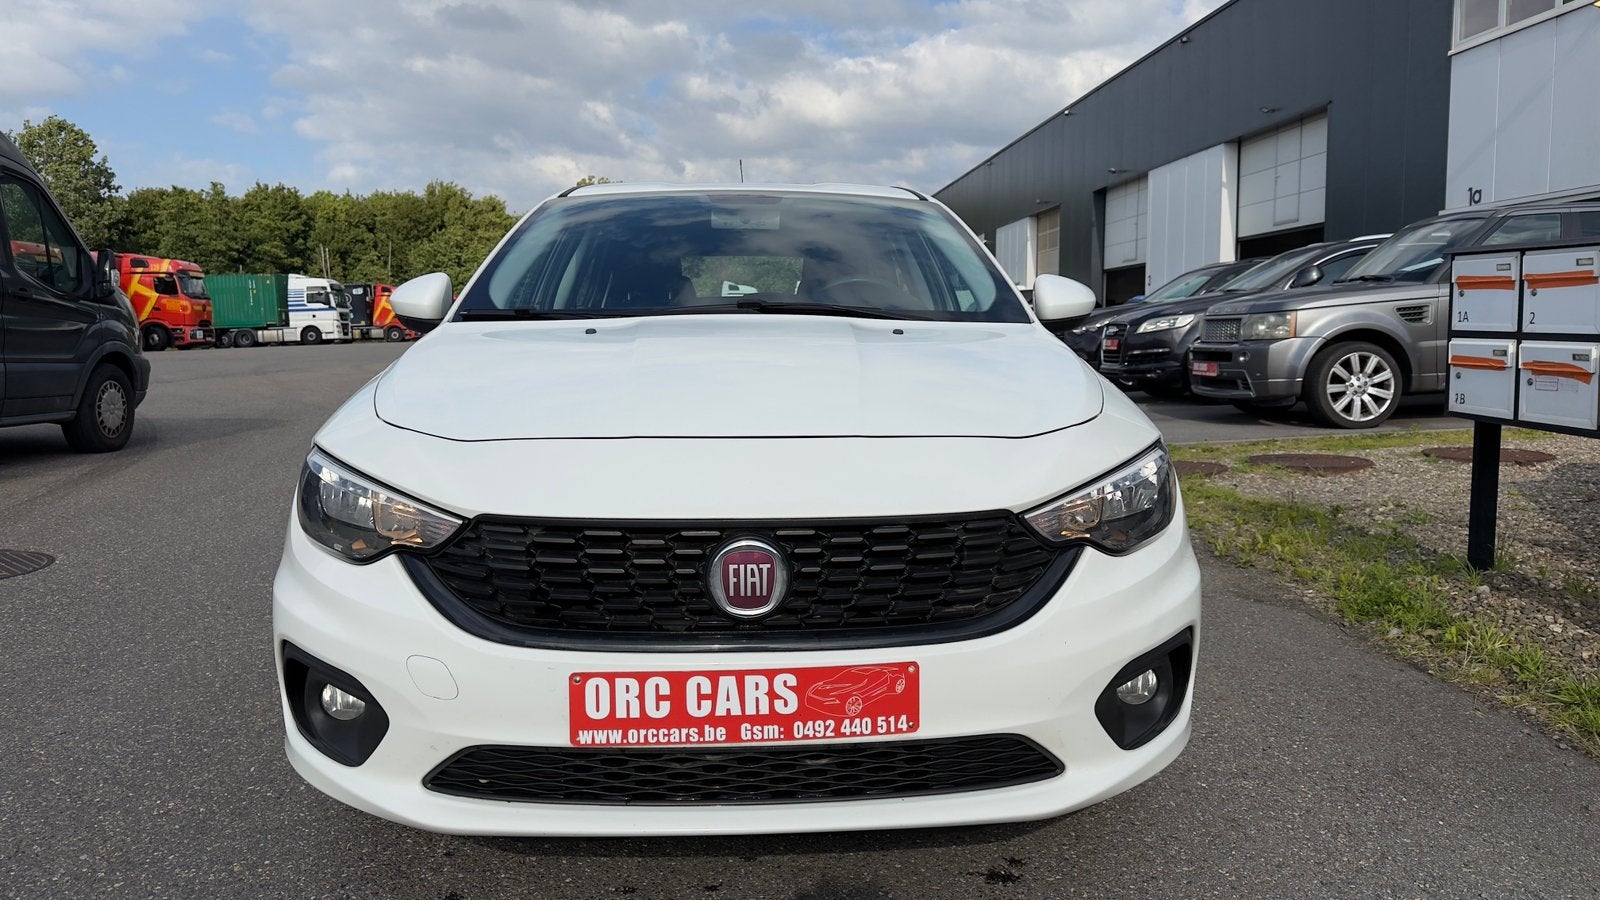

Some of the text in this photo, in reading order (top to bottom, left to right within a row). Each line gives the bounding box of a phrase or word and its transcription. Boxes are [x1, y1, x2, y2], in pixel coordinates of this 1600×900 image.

[1457, 311, 1469, 323] 1A
[1529, 312, 1536, 325] 2
[728, 563, 772, 597] FIAT
[584, 673, 799, 720] ORC CARS
[578, 714, 908, 745] www.orccars.be Gsm: 0492 440 514
